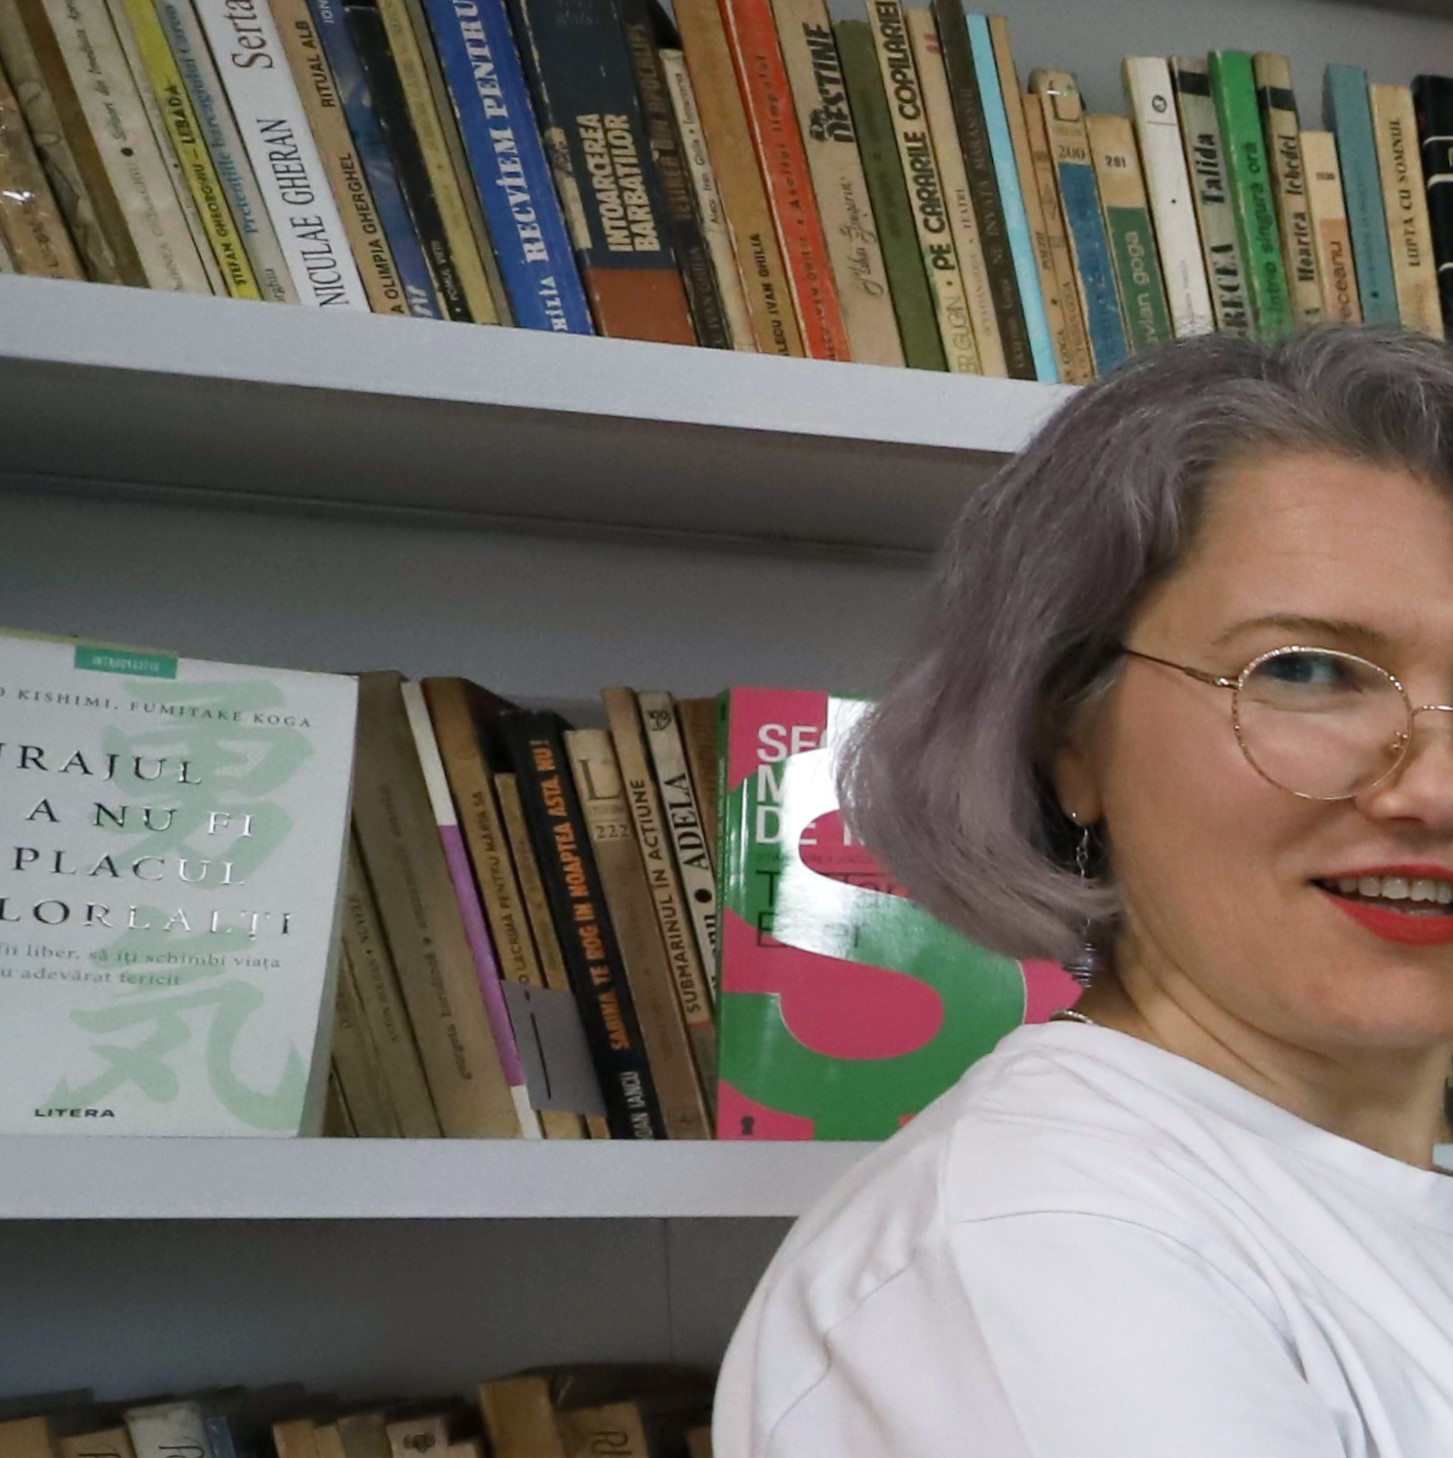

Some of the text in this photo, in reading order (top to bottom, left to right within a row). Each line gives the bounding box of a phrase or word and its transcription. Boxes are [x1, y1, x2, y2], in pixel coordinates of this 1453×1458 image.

[803, 22, 855, 143] DESTINE
[295, 20, 402, 302] OLIMPIA GHERGHEL RITUAL ALB
[577, 113, 635, 252] INTOARCEREA
[604, 114, 660, 252] BARBATILOR
[1194, 133, 1227, 207] Talida
[258, 118, 348, 309] NICULAE GHERAN
[750, 233, 772, 279] GHILIA
[933, 243, 953, 271] PE
[1125, 230, 1151, 287] goga
[1405, 221, 1422, 268] LUPTA
[761, 281, 782, 315] IVAN
[130, 700, 243, 722] FUMITAKE
[254, 713, 312, 729] KOGA
[26, 797, 255, 838] A NU FI
[595, 823, 632, 840] 222
[664, 771, 713, 872] ADELA
[13, 846, 245, 887] PLACUL
[550, 823, 594, 899] NOAPTEA
[145, 950, 227, 969] schimbi
[579, 926, 612, 962] ROG
[656, 894, 703, 1015] SUBMARINUL
[21, 966, 116, 986] adevărat
[33, 1106, 117, 1120] LITERA
[620, 1071, 642, 1112] IANCU
